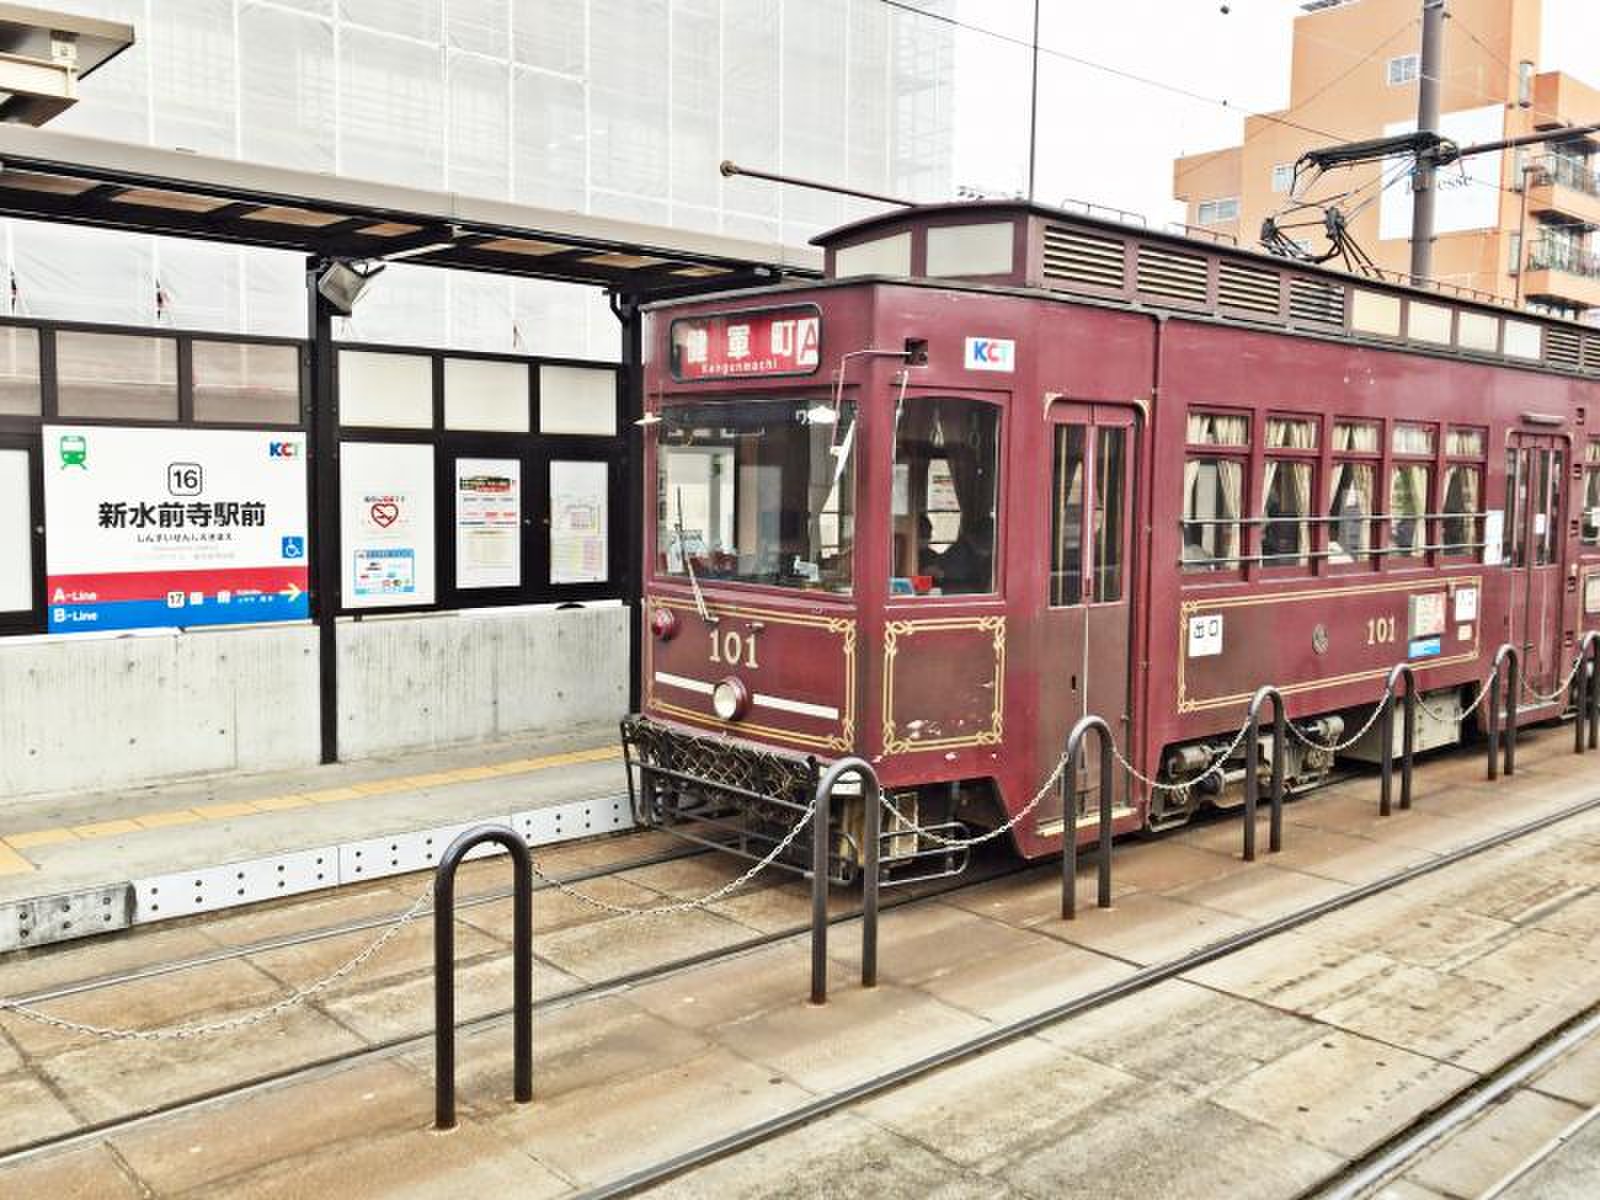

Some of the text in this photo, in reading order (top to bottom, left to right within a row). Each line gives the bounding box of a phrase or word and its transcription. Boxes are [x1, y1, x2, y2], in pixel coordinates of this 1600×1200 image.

[173, 469, 198, 489] 16
[98, 501, 266, 529] 新水前寺駅前
[1367, 616, 1395, 645] 101
[708, 629, 759, 669] 101
